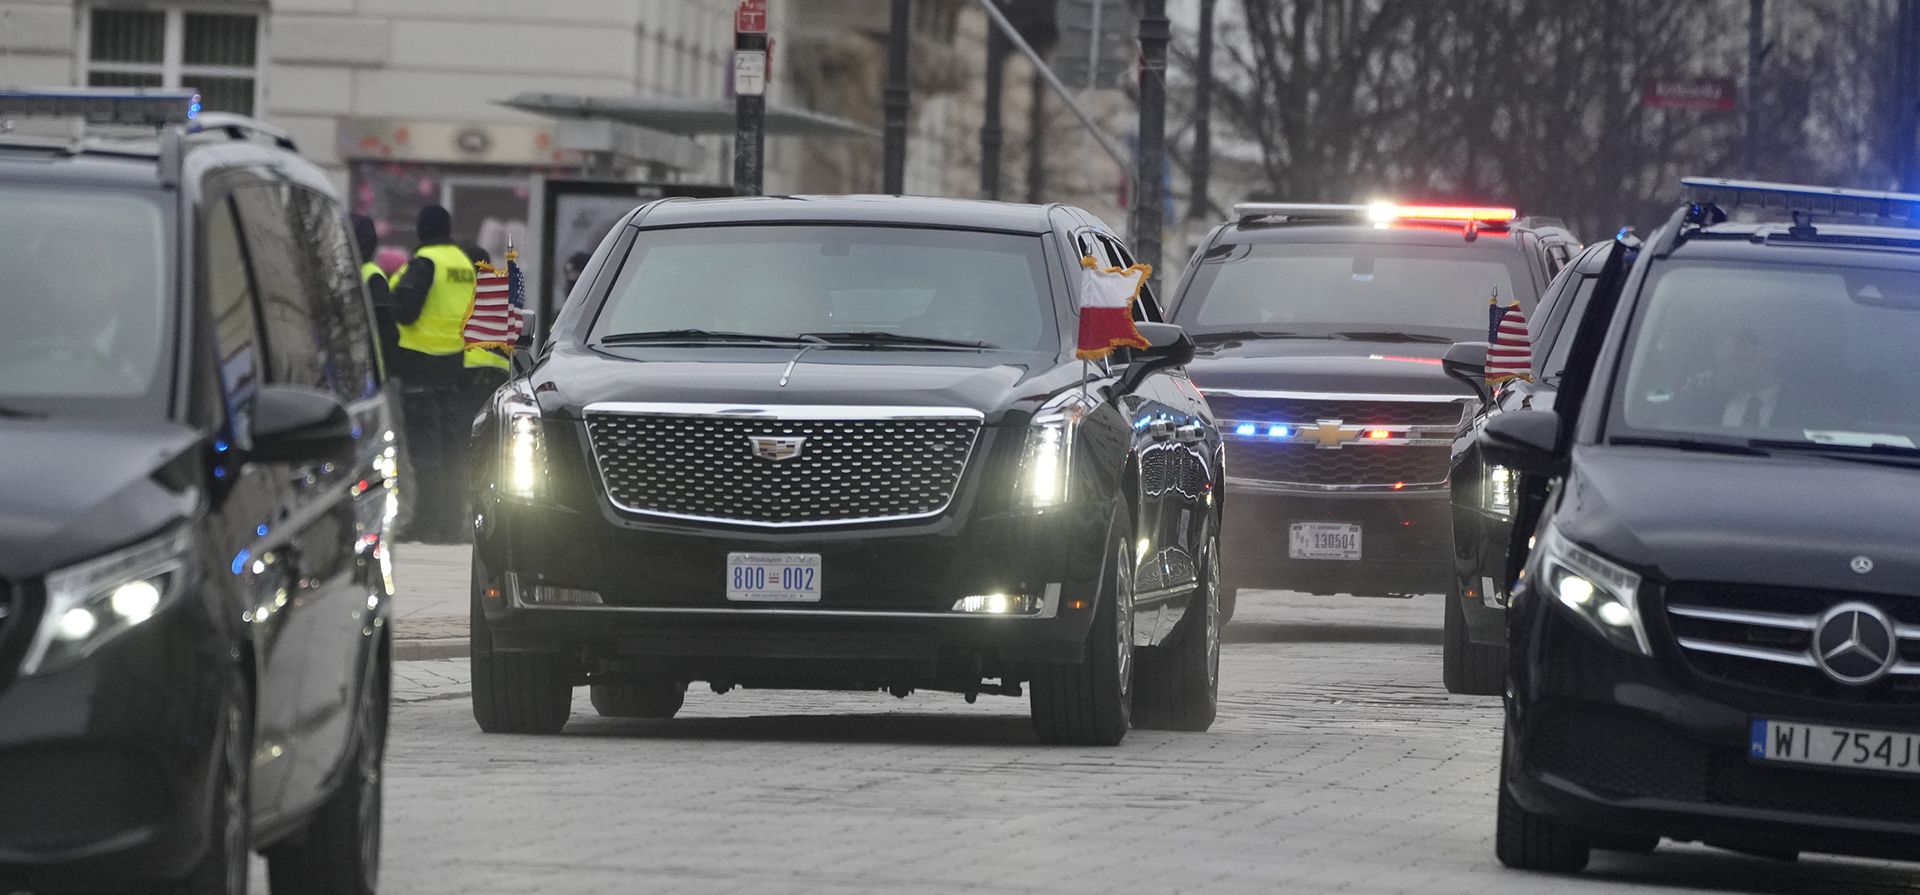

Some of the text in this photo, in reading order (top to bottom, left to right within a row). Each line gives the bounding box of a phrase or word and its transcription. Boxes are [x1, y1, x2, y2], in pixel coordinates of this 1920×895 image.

[1315, 533, 1356, 550] 130504
[734, 566, 815, 591] 800 002
[1775, 726, 1920, 768] WI 754J
